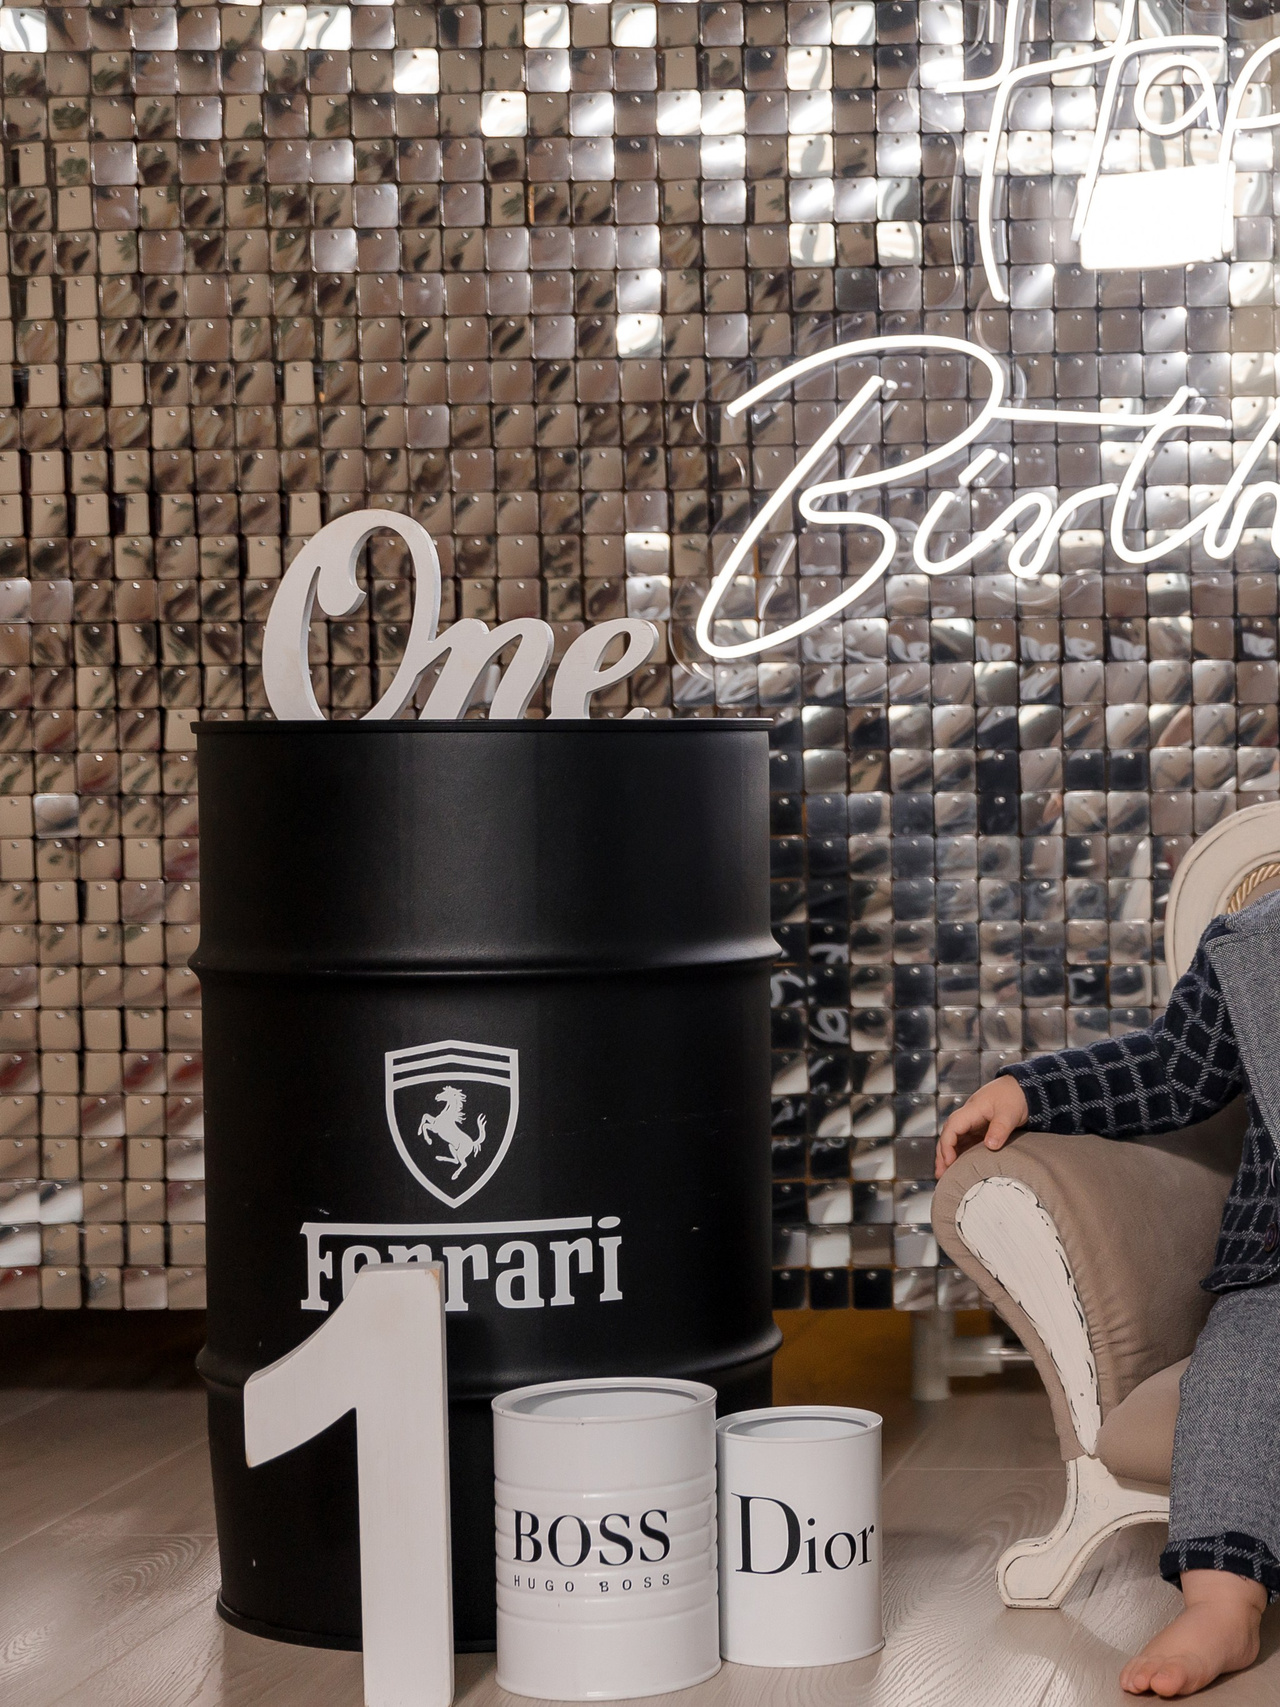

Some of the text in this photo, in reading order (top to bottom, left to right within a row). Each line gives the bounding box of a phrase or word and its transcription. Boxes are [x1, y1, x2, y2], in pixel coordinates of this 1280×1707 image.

[261, 508, 660, 721] One
[243, 1260, 455, 1707] 1
[512, 1508, 672, 1568] BOSS
[730, 1491, 876, 1575] Dior
[513, 1572, 671, 1593] HUGO BOSS
